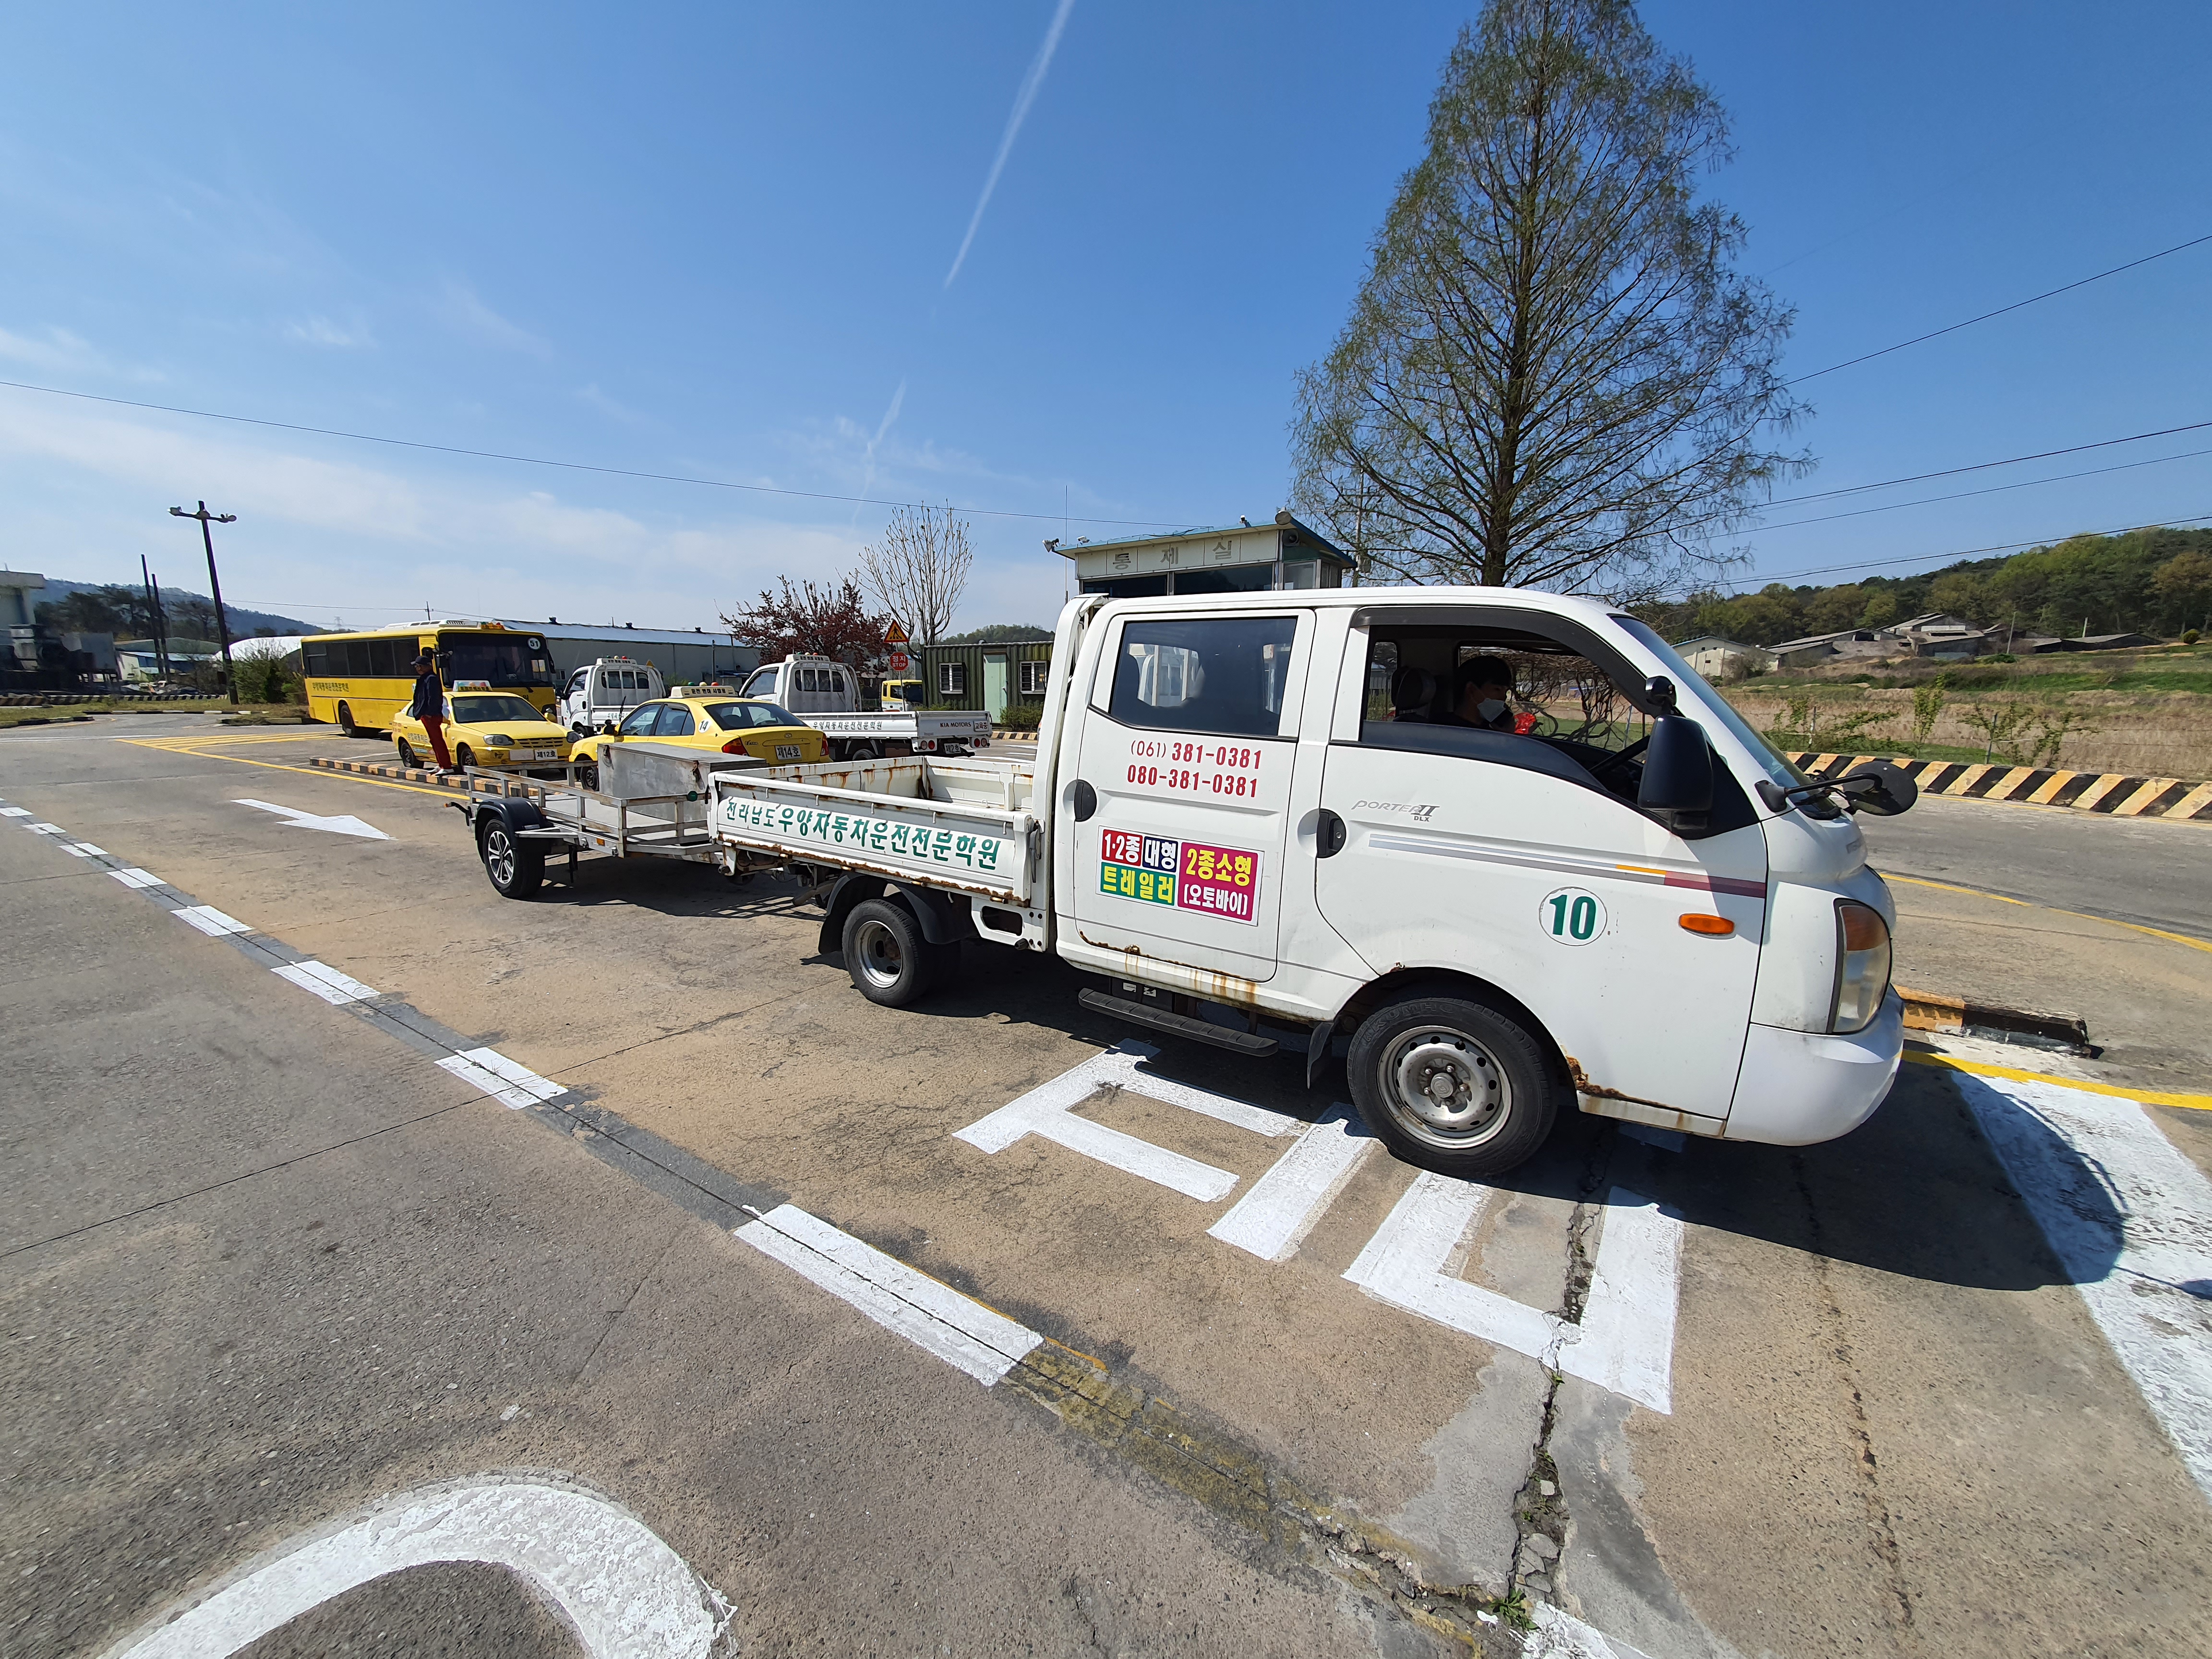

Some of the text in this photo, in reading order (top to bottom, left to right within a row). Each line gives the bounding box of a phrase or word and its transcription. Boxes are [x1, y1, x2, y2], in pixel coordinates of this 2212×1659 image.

[1113, 541, 1232, 570] 통제실
[699, 721, 709, 731] 14
[813, 721, 882, 730] 우양자동차운전전문학원
[777, 746, 801, 758] 제14호
[946, 744, 960, 753] 제2호
[1131, 740, 1262, 769] (061) 381-0381
[1128, 765, 1257, 797] 080-381-0381
[1144, 839, 1176, 869] 대형
[1186, 848, 1252, 887] 2종소형
[1103, 866, 1173, 904] 트레일러
[1549, 894, 1596, 940] 10
